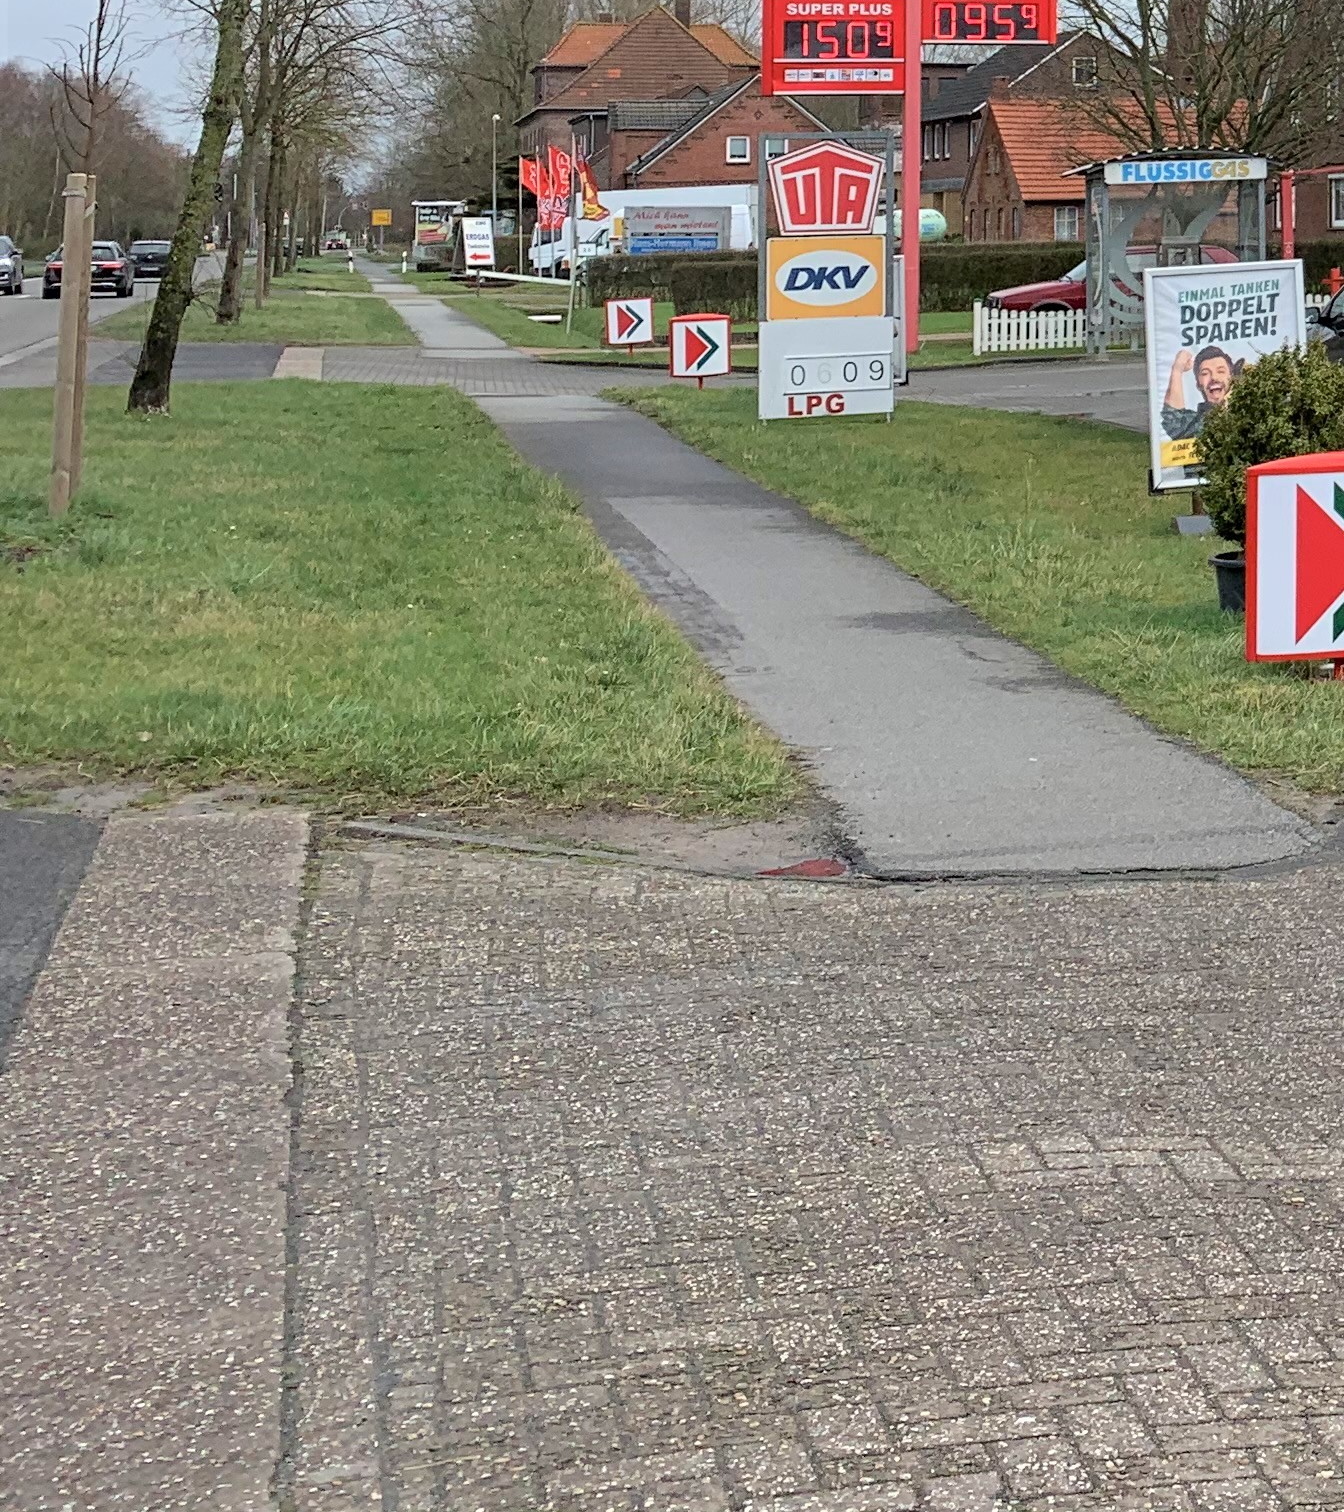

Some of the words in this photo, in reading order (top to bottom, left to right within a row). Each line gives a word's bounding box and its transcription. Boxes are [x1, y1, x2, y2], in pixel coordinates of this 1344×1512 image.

[786, 4, 844, 16] SUPER
[849, 3, 892, 15] PLUS
[933, 2, 1038, 41] 0959
[802, 20, 892, 59] 1509
[783, 264, 870, 292] DKV
[1178, 286, 1226, 304] EINMAL
[1230, 278, 1280, 297] TANKEN
[1180, 292, 1280, 325] DOPPELT
[1181, 315, 1278, 347] SPAREN!
[787, 393, 845, 417] LPG
